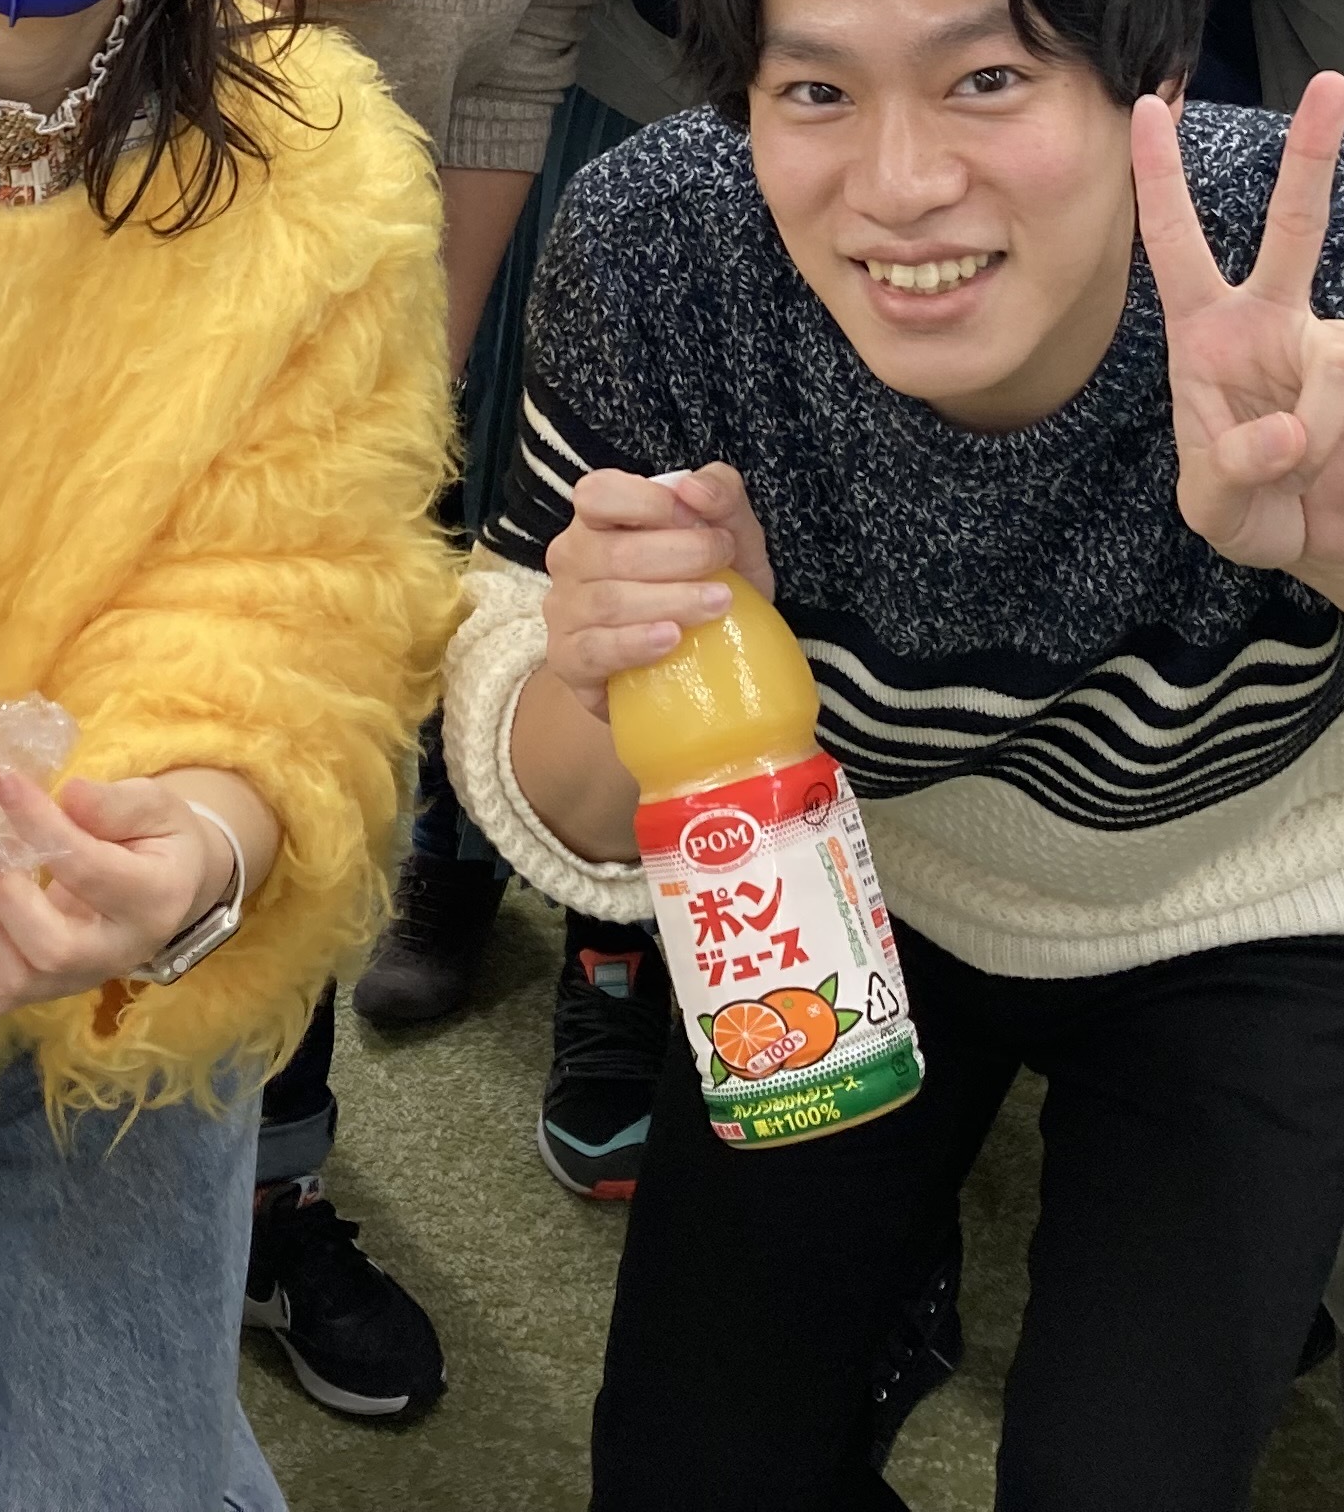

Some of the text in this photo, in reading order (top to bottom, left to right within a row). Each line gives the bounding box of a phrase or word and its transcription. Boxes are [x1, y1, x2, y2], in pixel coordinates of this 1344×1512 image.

[688, 823, 750, 858] POM
[688, 877, 783, 946] ポン
[695, 927, 810, 987] ジュース
[753, 1100, 841, 1137] 果汁100%
